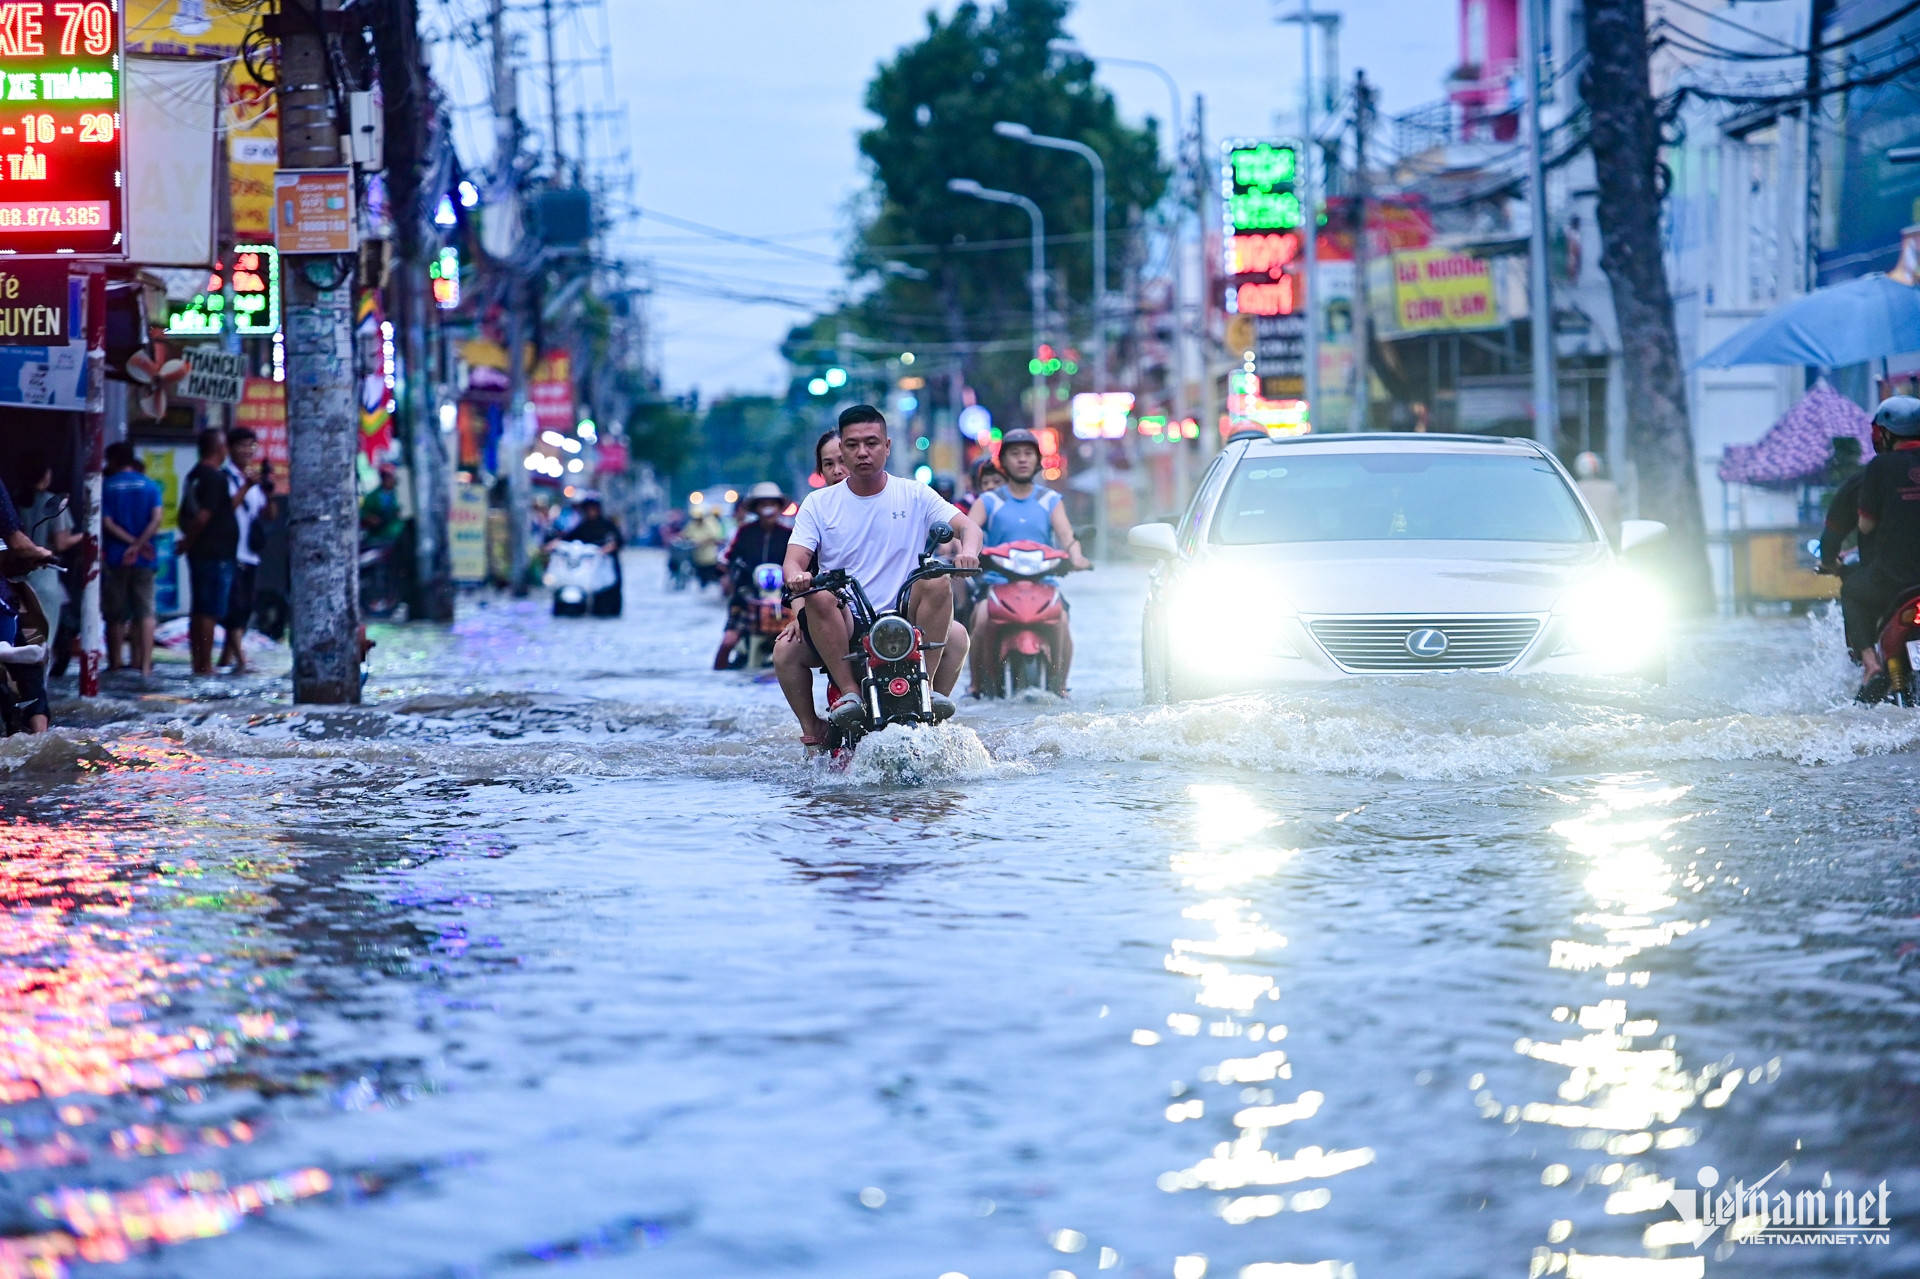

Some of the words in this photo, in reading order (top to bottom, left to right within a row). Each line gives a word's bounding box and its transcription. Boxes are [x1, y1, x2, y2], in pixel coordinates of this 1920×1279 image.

[55, 2, 111, 55] 79
[7, 72, 37, 100] XE
[40, 67, 113, 99] THÁNG
[22, 113, 56, 143] 16
[79, 113, 115, 142] 29
[7, 146, 47, 180] TẢI
[0, 305, 60, 336] UYÊN
